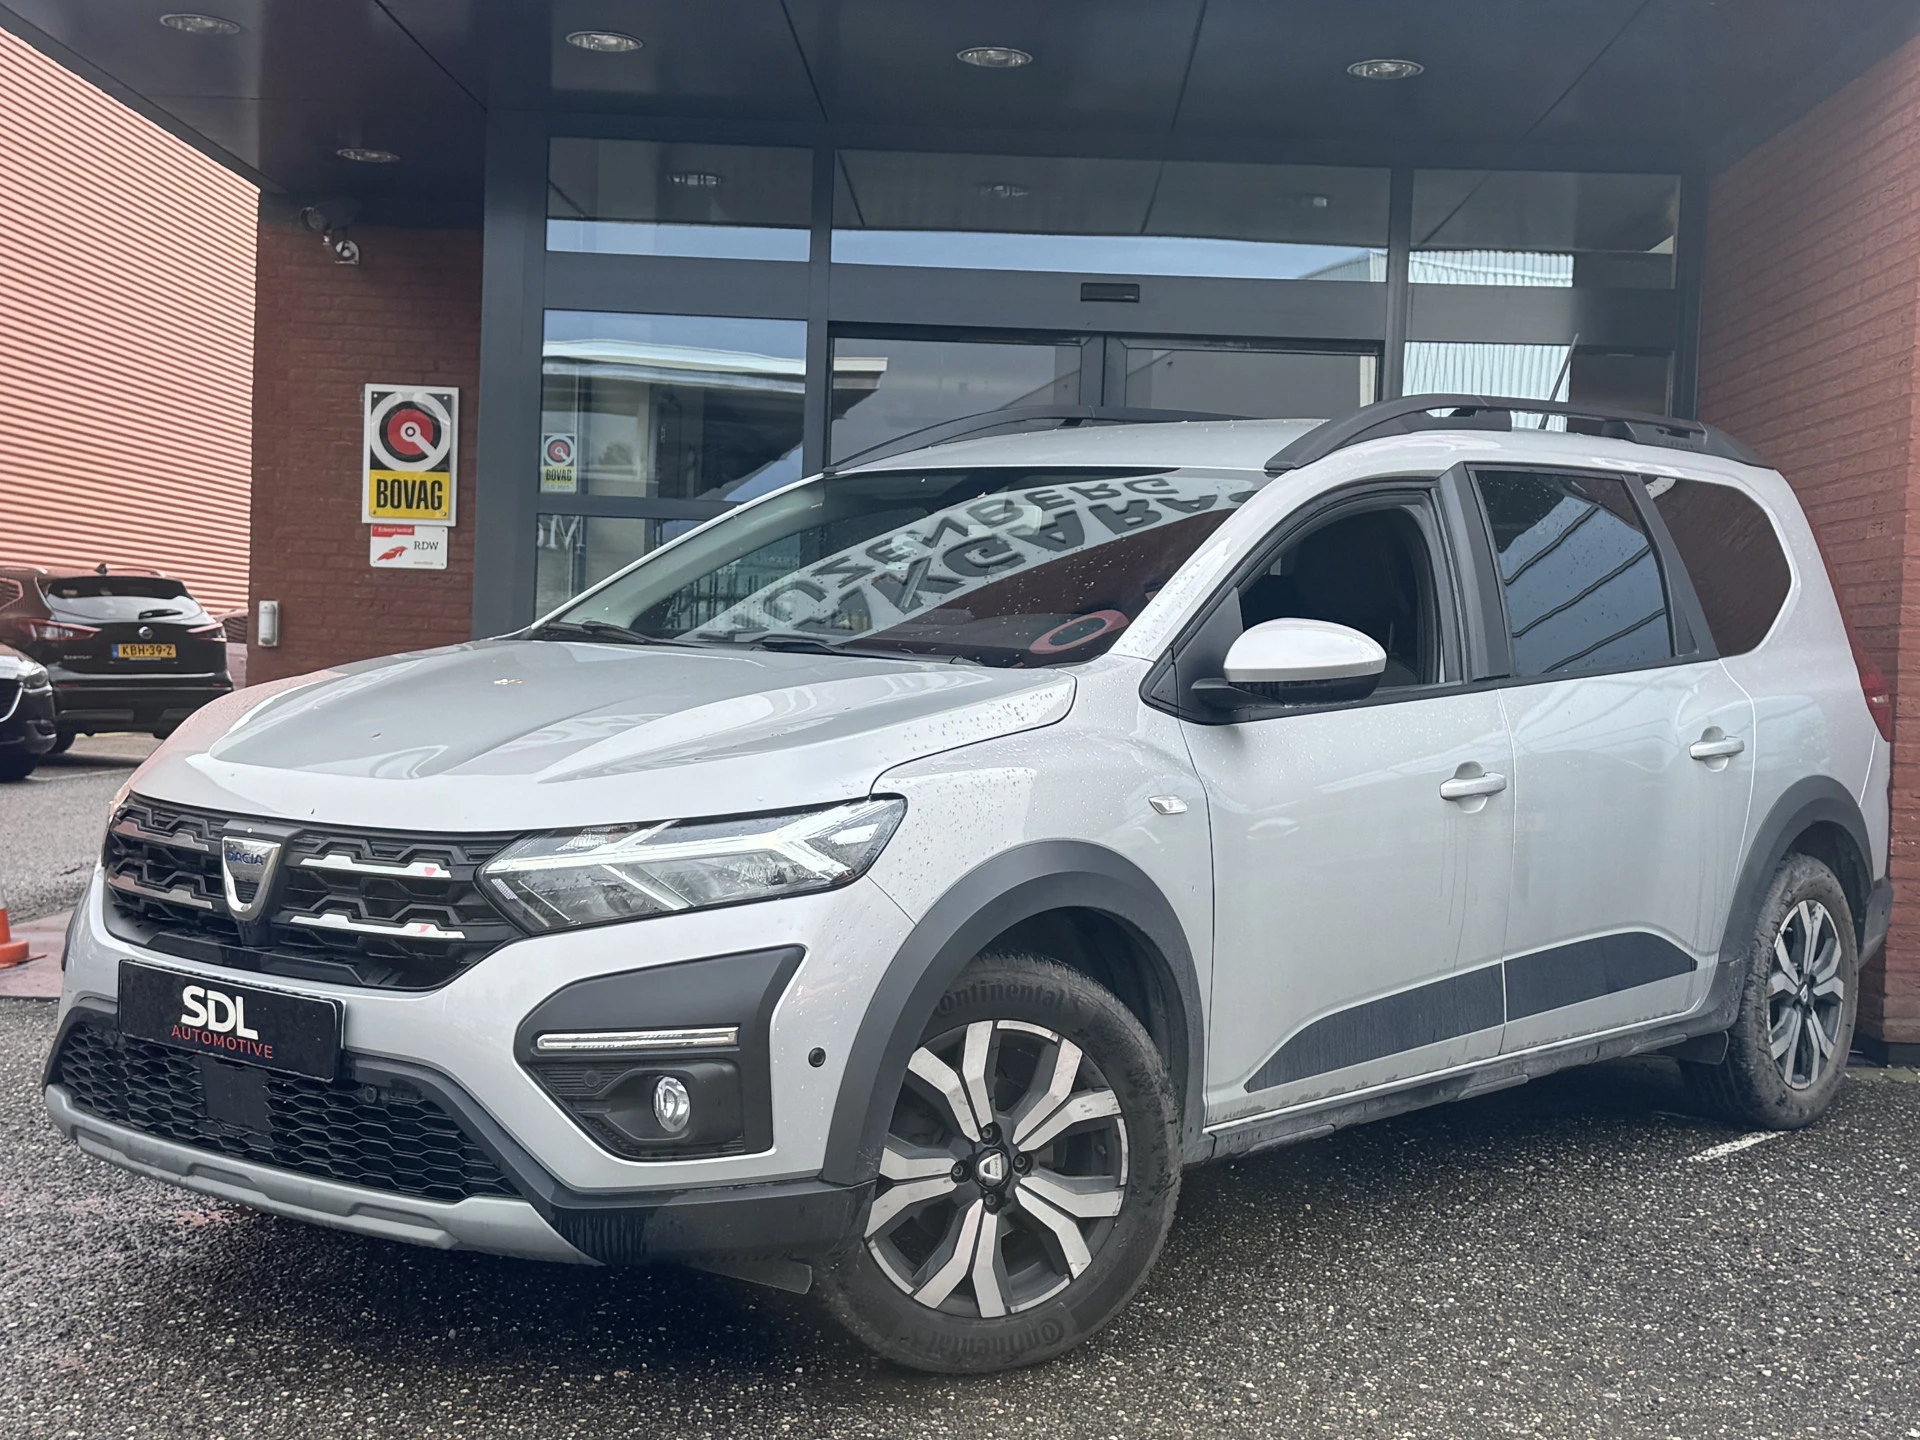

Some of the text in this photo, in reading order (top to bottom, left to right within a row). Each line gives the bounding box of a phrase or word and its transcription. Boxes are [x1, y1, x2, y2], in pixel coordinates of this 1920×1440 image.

[545, 468, 572, 482] BOVAG
[376, 478, 443, 511] BOVAG
[413, 541, 439, 551] RDW
[122, 642, 173, 656] KBH-39-Z
[226, 851, 264, 866] DACIA
[181, 985, 259, 1040] SDL
[171, 1024, 274, 1059] AUTOMOTIVE
